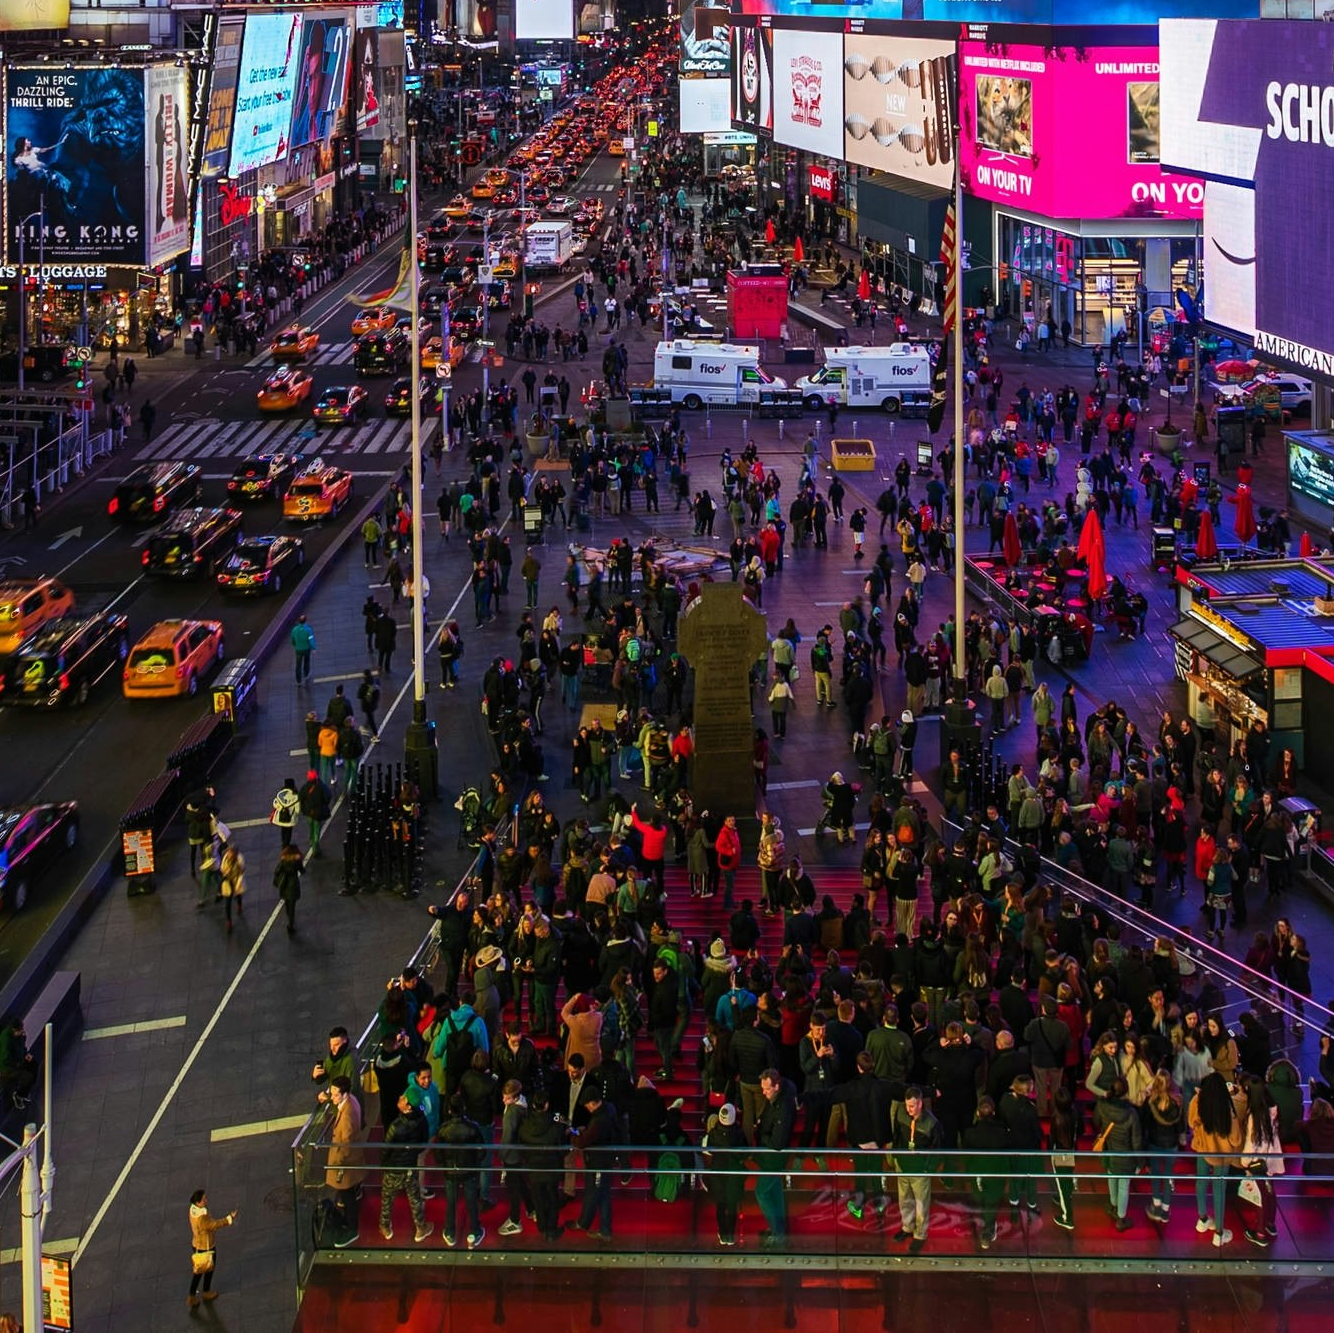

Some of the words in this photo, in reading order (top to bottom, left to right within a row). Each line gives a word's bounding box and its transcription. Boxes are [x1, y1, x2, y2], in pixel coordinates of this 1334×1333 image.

[1095, 63, 1160, 74] UNLIMITED
[17, 86, 65, 97] DAZZLING
[194, 69, 207, 120] MAC
[11, 97, 44, 108] THRILL
[262, 92, 272, 106] free
[886, 93, 907, 112] NEW
[187, 123, 199, 174] MAC
[977, 165, 989, 184] ON
[991, 168, 1017, 192] YOUR
[1019, 175, 1032, 196] TV
[15, 225, 67, 238] KING
[80, 225, 139, 238] KONG
[30, 266, 107, 278] LUGGAGE
[892, 365, 914, 376] fios
